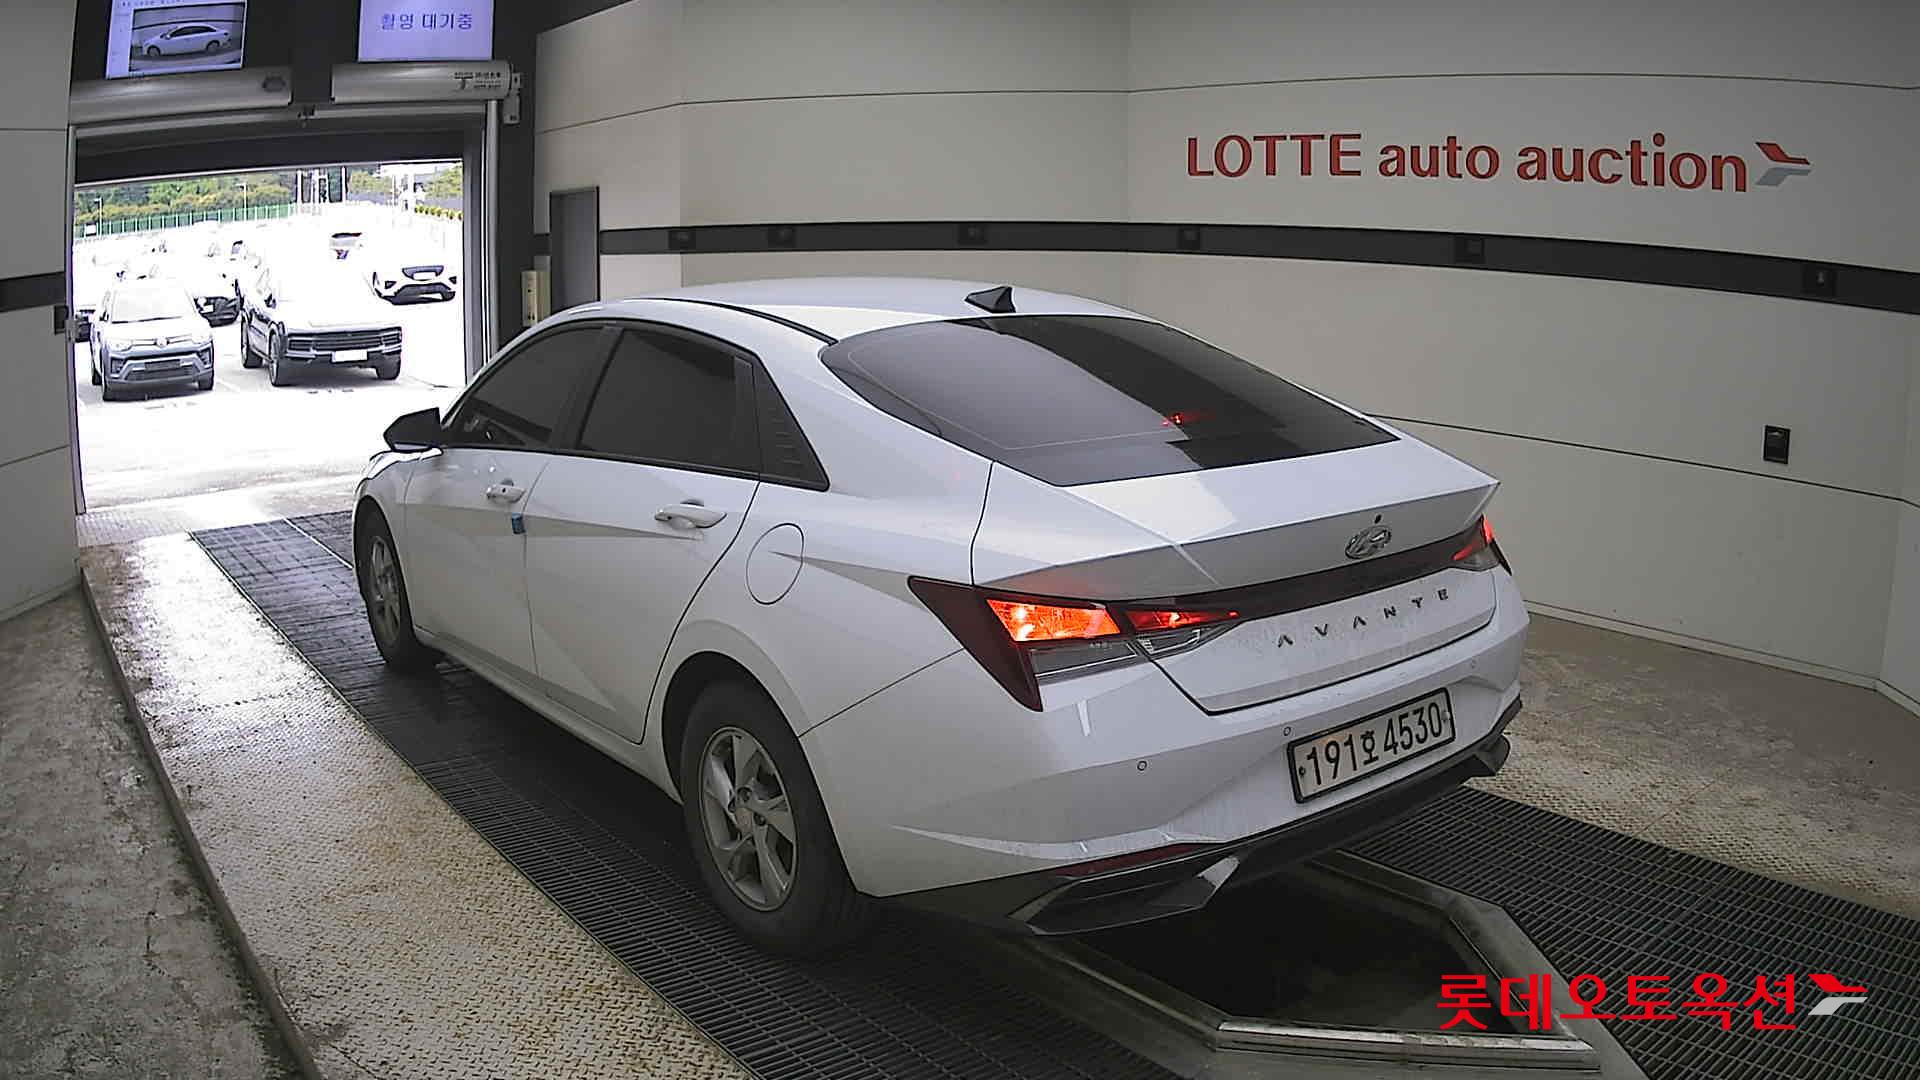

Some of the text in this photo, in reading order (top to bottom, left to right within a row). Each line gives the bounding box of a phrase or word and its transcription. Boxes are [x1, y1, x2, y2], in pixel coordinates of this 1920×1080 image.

[422, 13, 472, 30] 대기중
[1186, 132, 1747, 192] LOTTE auto auction
[1277, 588, 1448, 648] AVANTE
[1383, 702, 1443, 755] 4530
